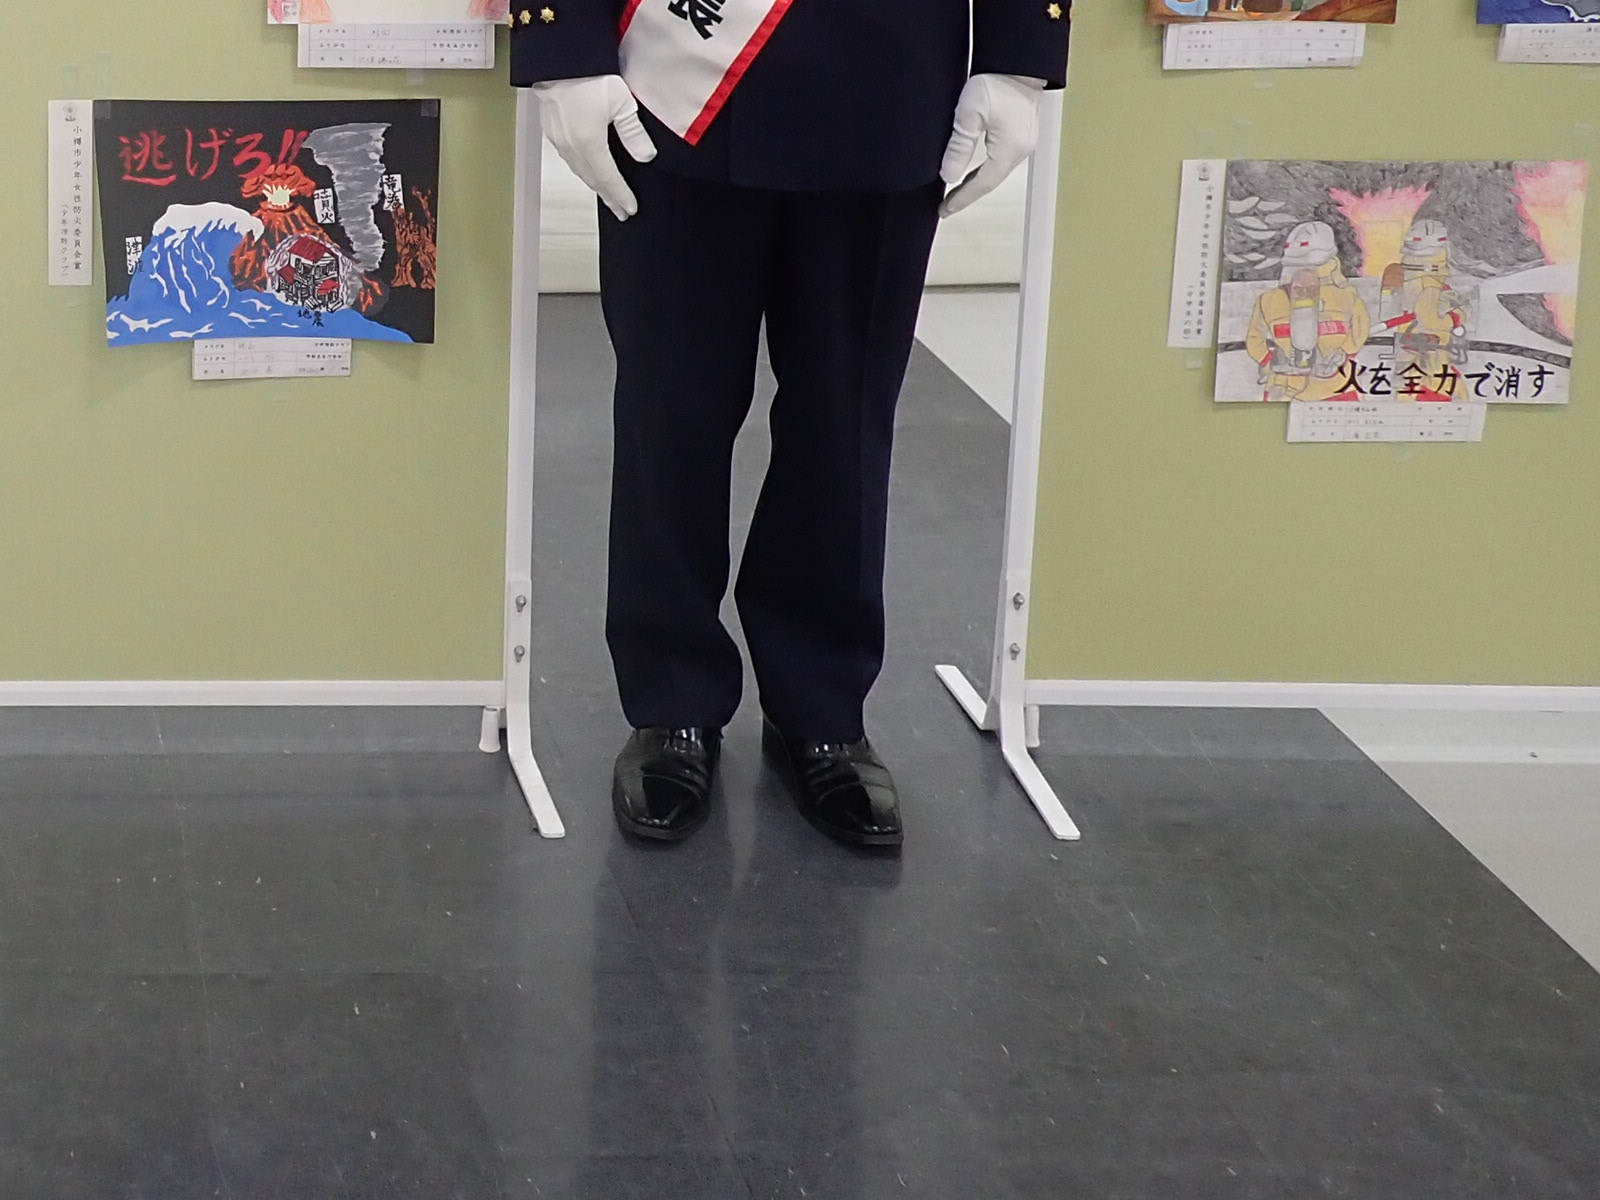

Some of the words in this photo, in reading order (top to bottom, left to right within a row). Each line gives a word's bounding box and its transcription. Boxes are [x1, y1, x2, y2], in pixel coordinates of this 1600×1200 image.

[314, 189, 334, 223] 噴火
[126, 238, 144, 275] 津波
[1333, 359, 1555, 399] 火を全力で消す
